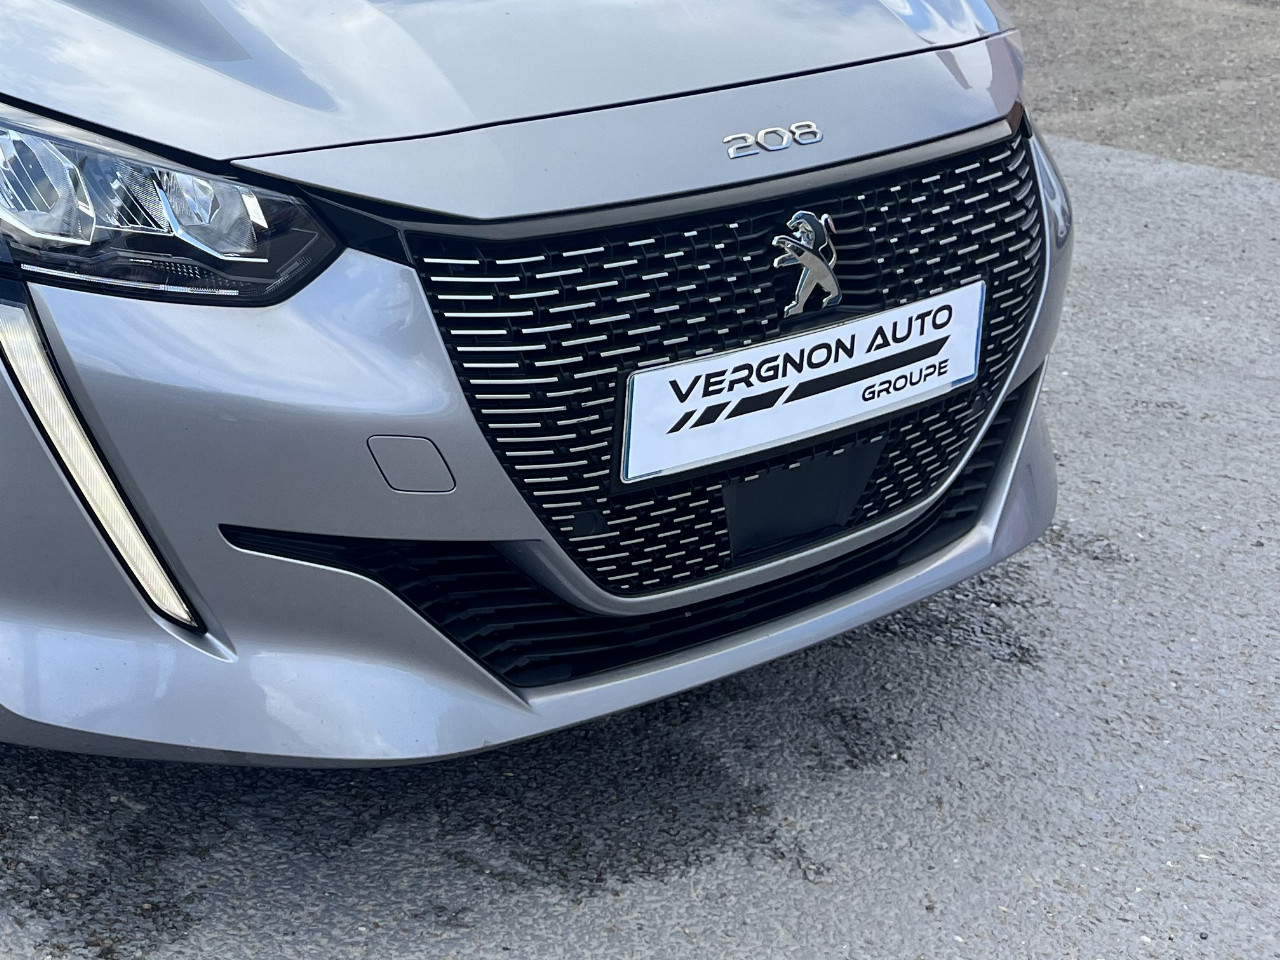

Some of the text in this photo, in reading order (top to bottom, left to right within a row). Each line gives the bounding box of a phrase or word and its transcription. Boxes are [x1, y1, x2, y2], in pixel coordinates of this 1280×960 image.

[723, 121, 823, 160] 208
[669, 304, 953, 403] VERGNON AUTO
[862, 358, 950, 402] GROUPE
